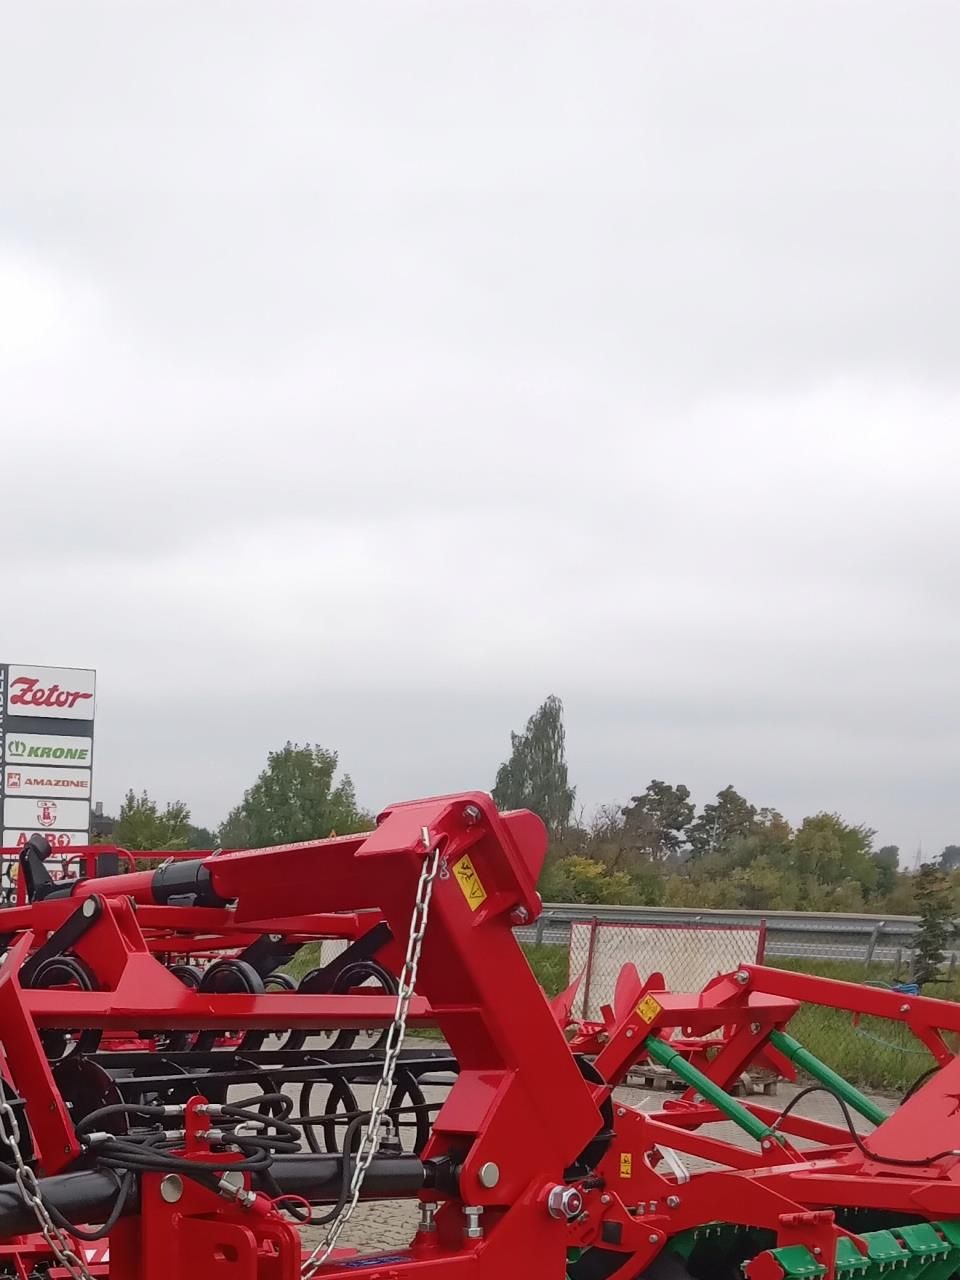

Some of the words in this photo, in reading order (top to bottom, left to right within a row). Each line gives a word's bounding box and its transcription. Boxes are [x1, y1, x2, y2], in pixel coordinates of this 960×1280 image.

[10, 676, 94, 708] Zetor
[27, 746, 89, 760] KRONE
[24, 778, 89, 788] AMAZONE
